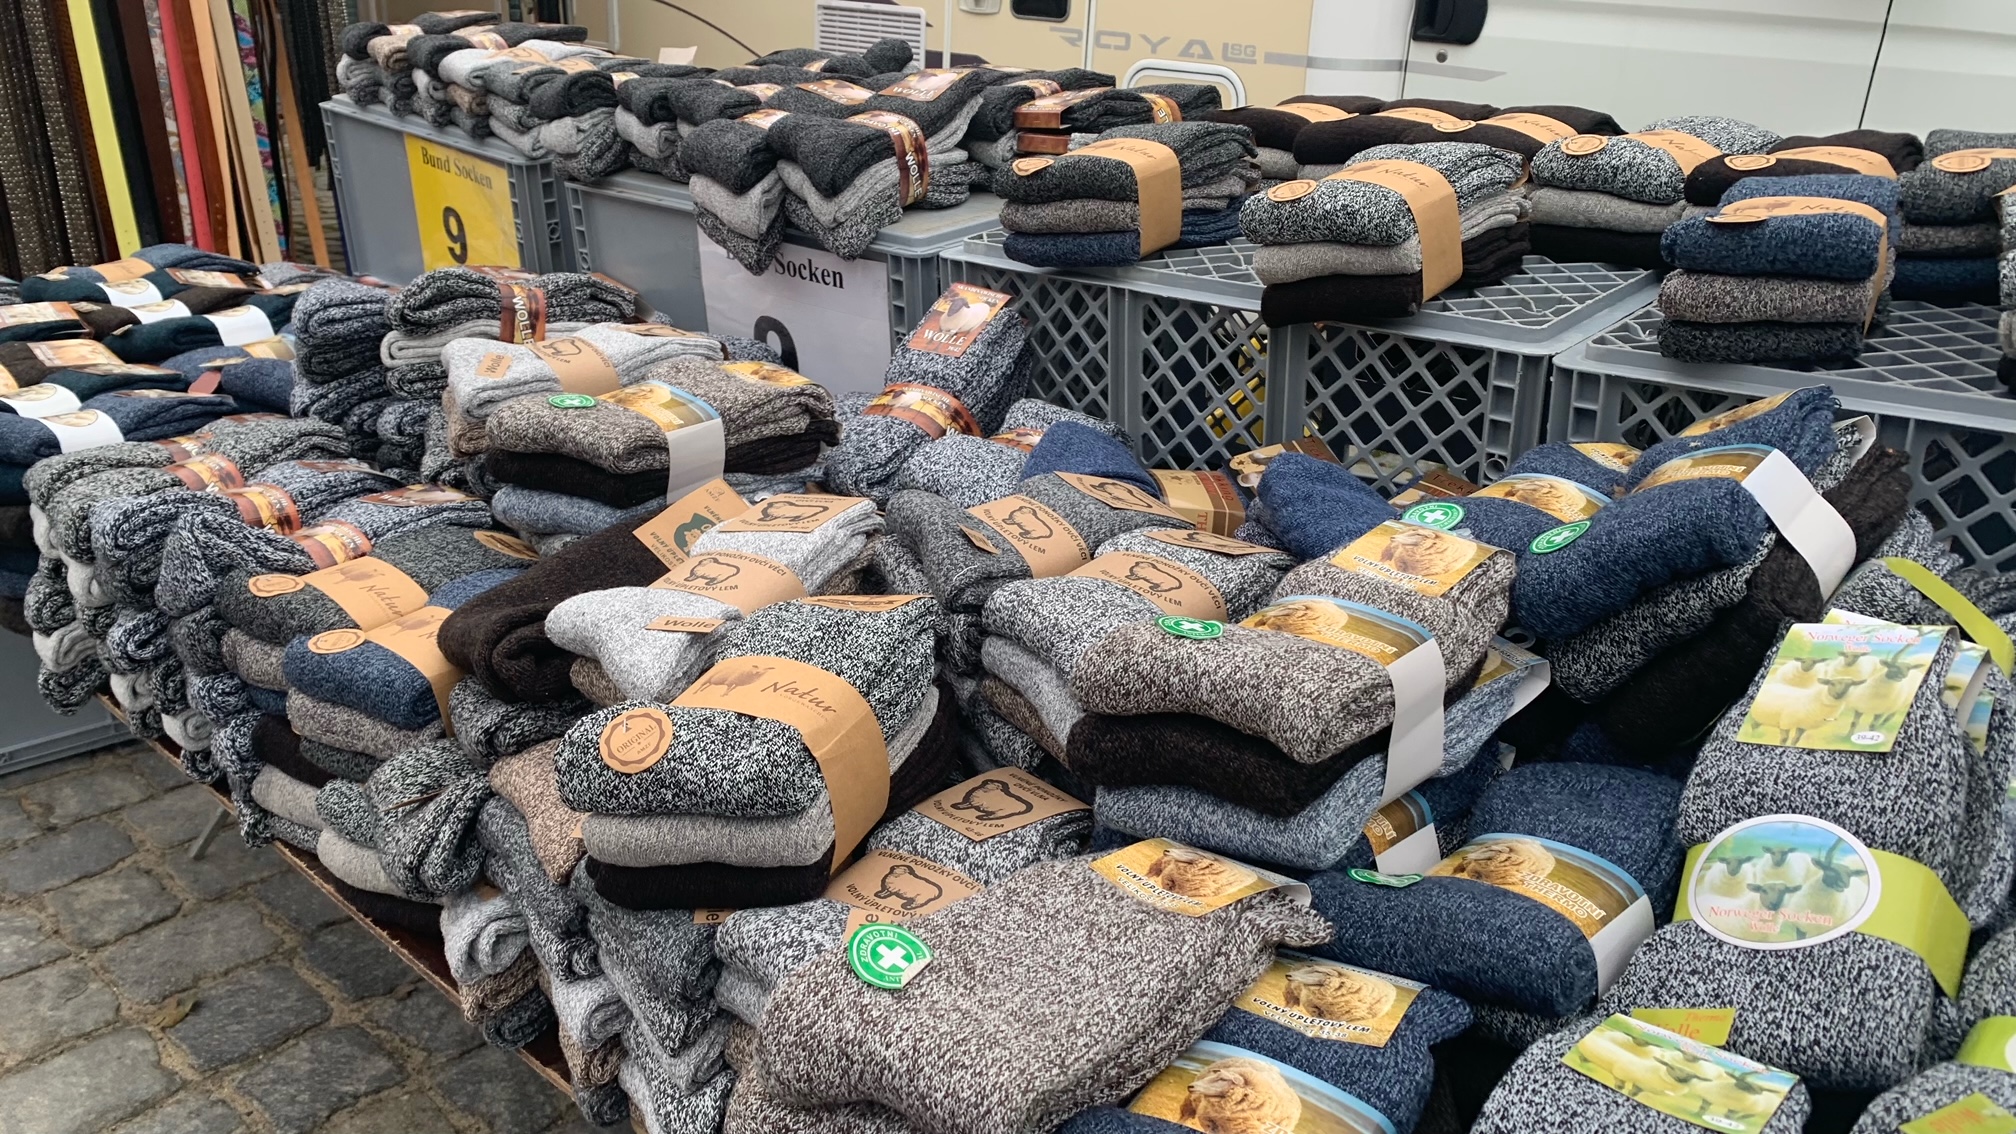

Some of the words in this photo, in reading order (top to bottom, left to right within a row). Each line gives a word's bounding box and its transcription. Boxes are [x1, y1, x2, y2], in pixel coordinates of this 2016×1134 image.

[1049, 26, 1257, 64] ROYAL
[420, 146, 451, 173] Bund
[453, 160, 493, 190] Socken
[904, 151, 924, 198] WOLLE
[1376, 167, 1430, 188] Natur
[442, 205, 468, 265] 9
[774, 251, 845, 290] Socken
[512, 296, 536, 346] WOLLE
[922, 328, 969, 347] WOLLE
[487, 354, 506, 374] Wolle
[1035, 502, 1067, 529] PONOŽKY
[650, 543, 678, 568] VELIKOST
[666, 546, 686, 565] ÚPLET
[1028, 542, 1046, 555] LEM
[749, 557, 770, 567] OVČÍ
[769, 564, 787, 577] VĚCI
[718, 584, 739, 592] LEM
[1149, 560, 1192, 582] PONOŽKY
[1207, 588, 1221, 609] VĚCI
[358, 583, 405, 618] Natur
[1163, 595, 1183, 607] LEM
[664, 619, 716, 629] Wolle
[1806, 631, 1869, 643] Norweger
[1874, 633, 1922, 644] Socken
[760, 680, 837, 714] Natur
[616, 723, 658, 754] ORIGINAL
[1854, 732, 1881, 743] 39-42
[1028, 789, 1050, 801] VLNA
[983, 821, 1005, 830] LEM
[877, 850, 911, 864] VLNĚNÉ
[908, 856, 955, 879] PONOŽKY
[951, 873, 977, 892] OVČÍ
[845, 883, 871, 906] VOLNÝ
[868, 895, 919, 920] ÚPLETOVÝ
[1520, 871, 1607, 921] ZDRAVOTNÍ
[1523, 880, 1588, 919] THERMO
[1709, 905, 1776, 921] Norweger
[1779, 910, 1834, 927] Socken
[1345, 1023, 1372, 1034] LEM
[1684, 1012, 1727, 1023] Thermo
